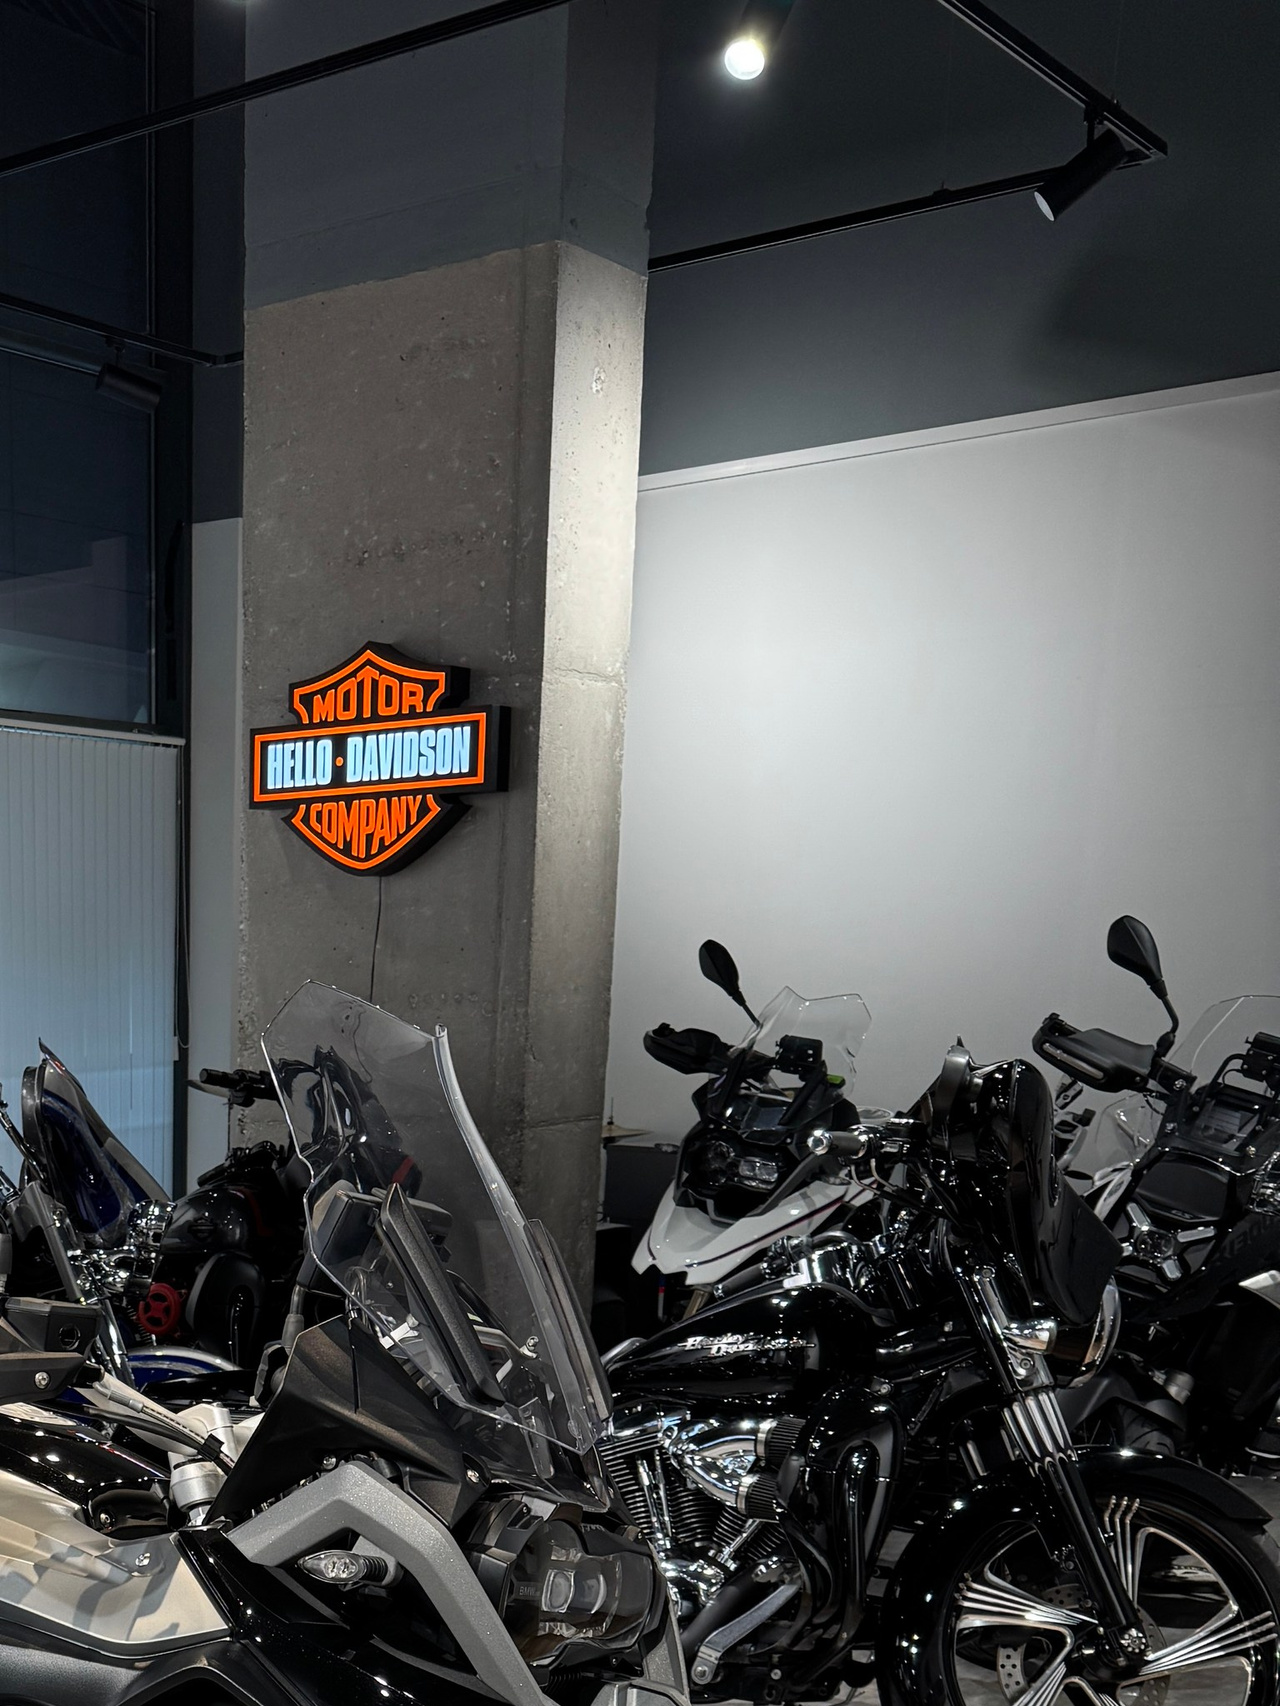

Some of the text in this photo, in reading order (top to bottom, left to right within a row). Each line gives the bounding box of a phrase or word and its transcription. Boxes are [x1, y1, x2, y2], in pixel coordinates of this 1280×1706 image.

[312, 665, 424, 724] MOTOR
[266, 725, 471, 790] HELLO DAVIDSON
[309, 794, 423, 859] COMPANY
